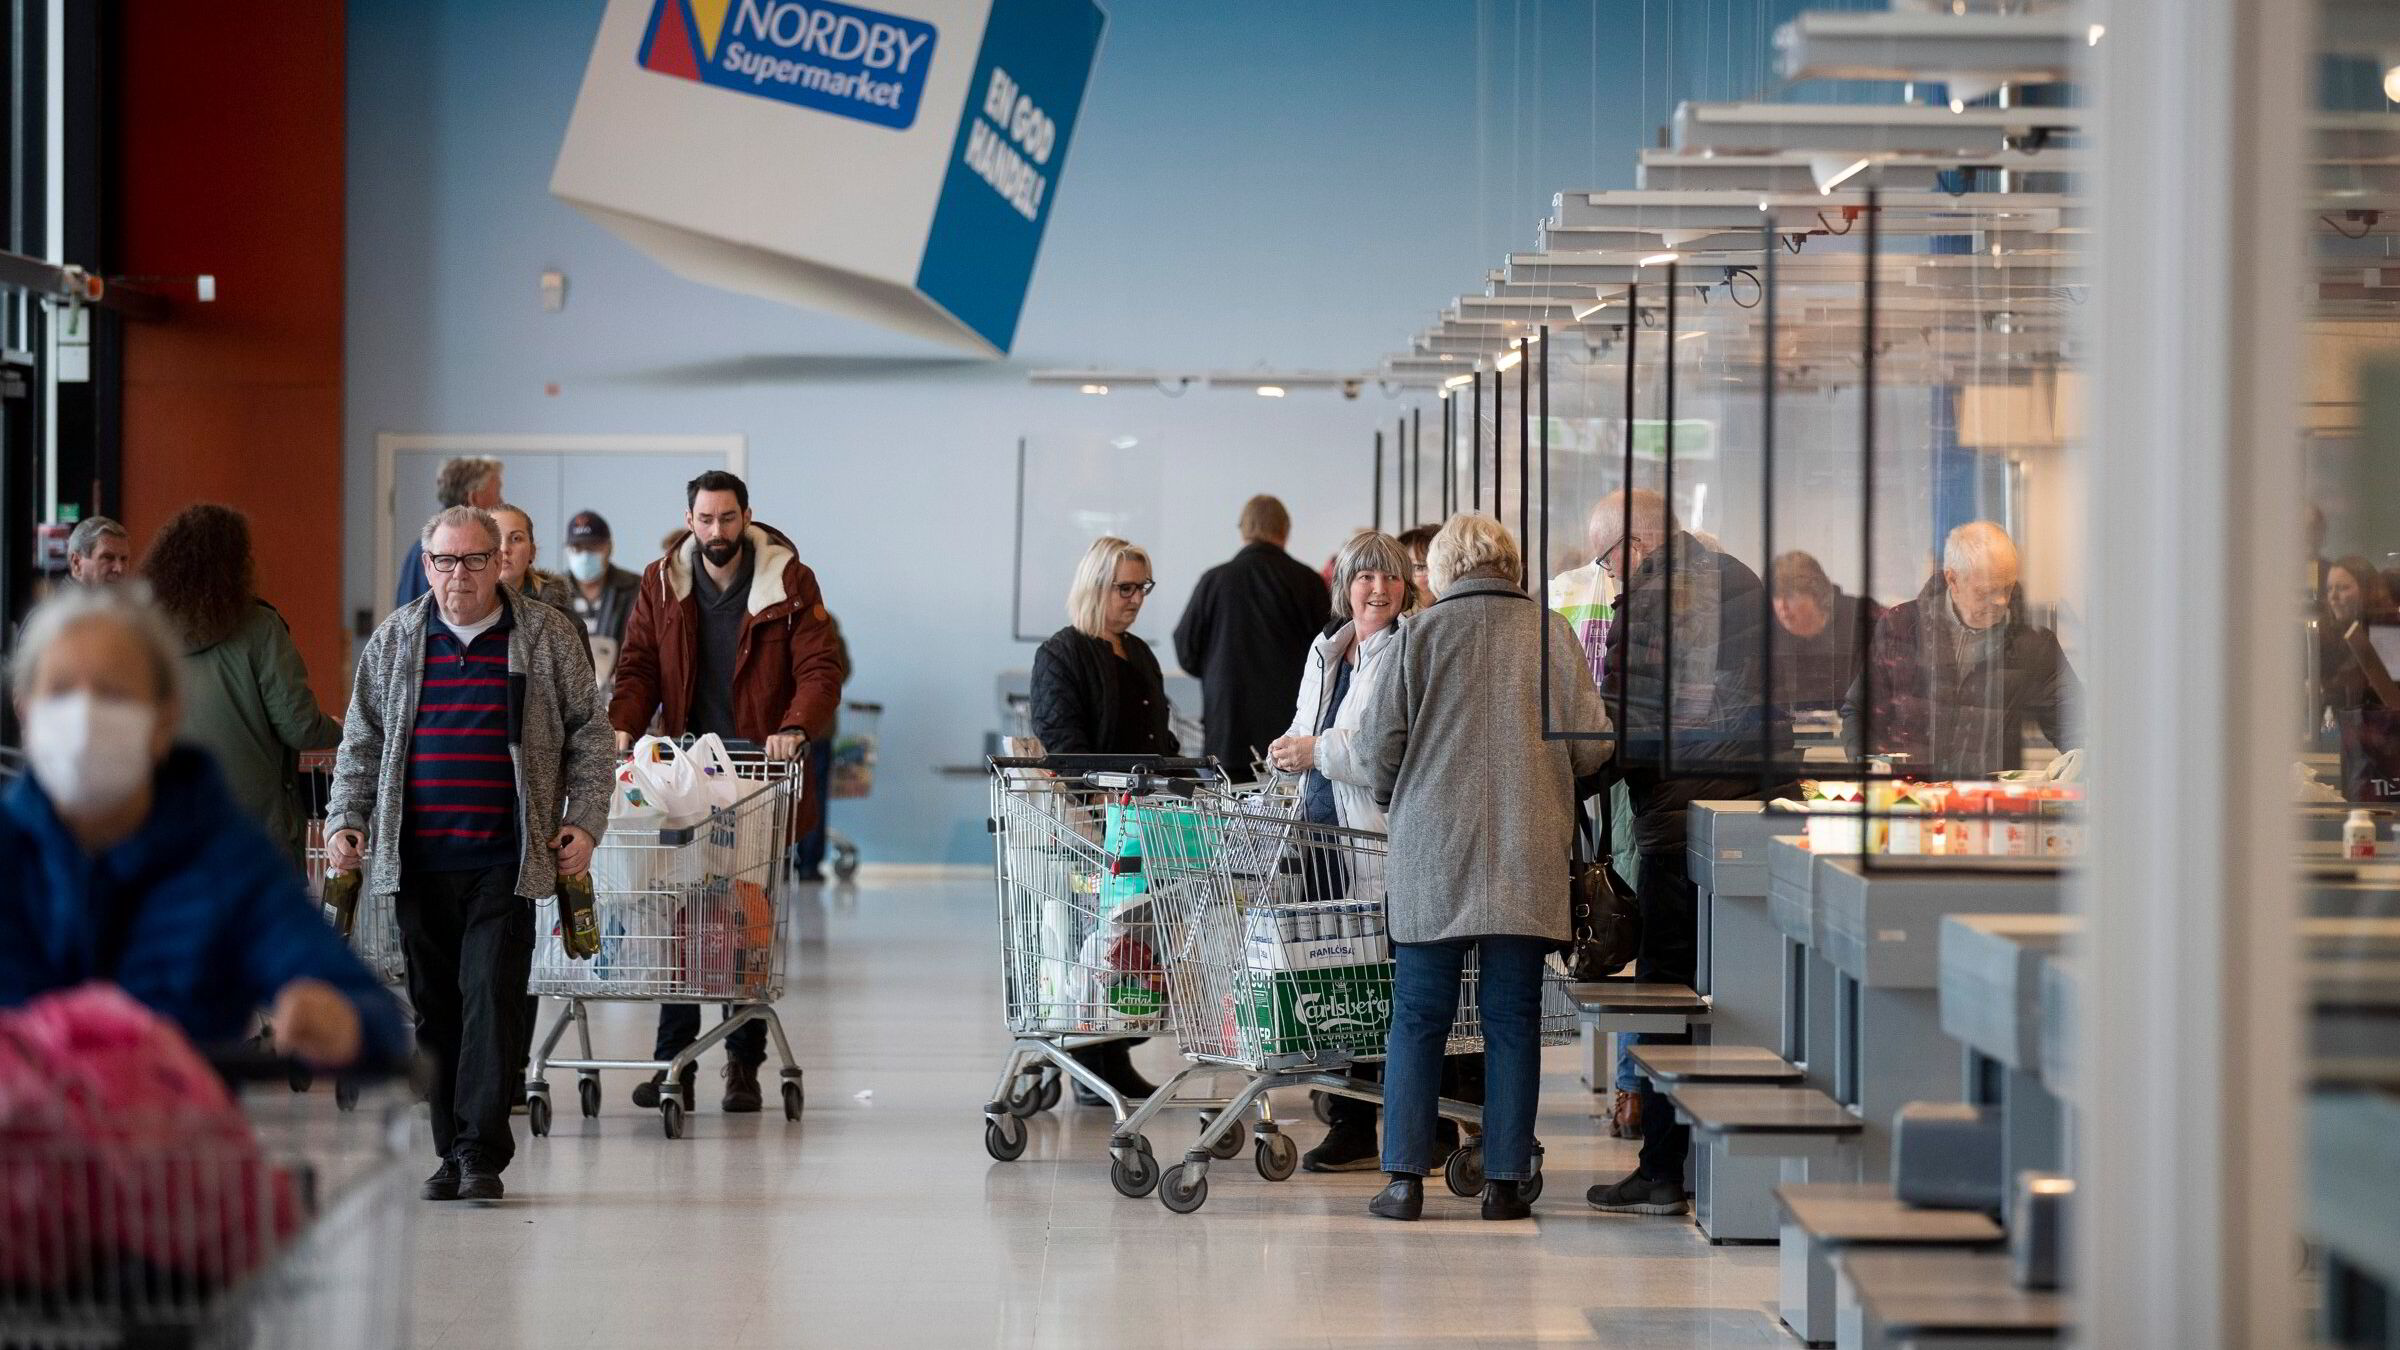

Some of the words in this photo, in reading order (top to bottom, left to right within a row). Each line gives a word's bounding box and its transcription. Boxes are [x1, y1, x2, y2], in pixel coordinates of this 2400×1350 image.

[732, 0, 928, 74] NORDBY
[723, 41, 903, 110] Supermarket
[983, 66, 1019, 130] EN
[1010, 94, 1056, 165] GOD
[964, 116, 1046, 222] HANDEL!
[1295, 989, 1390, 1027] Carlsberg
